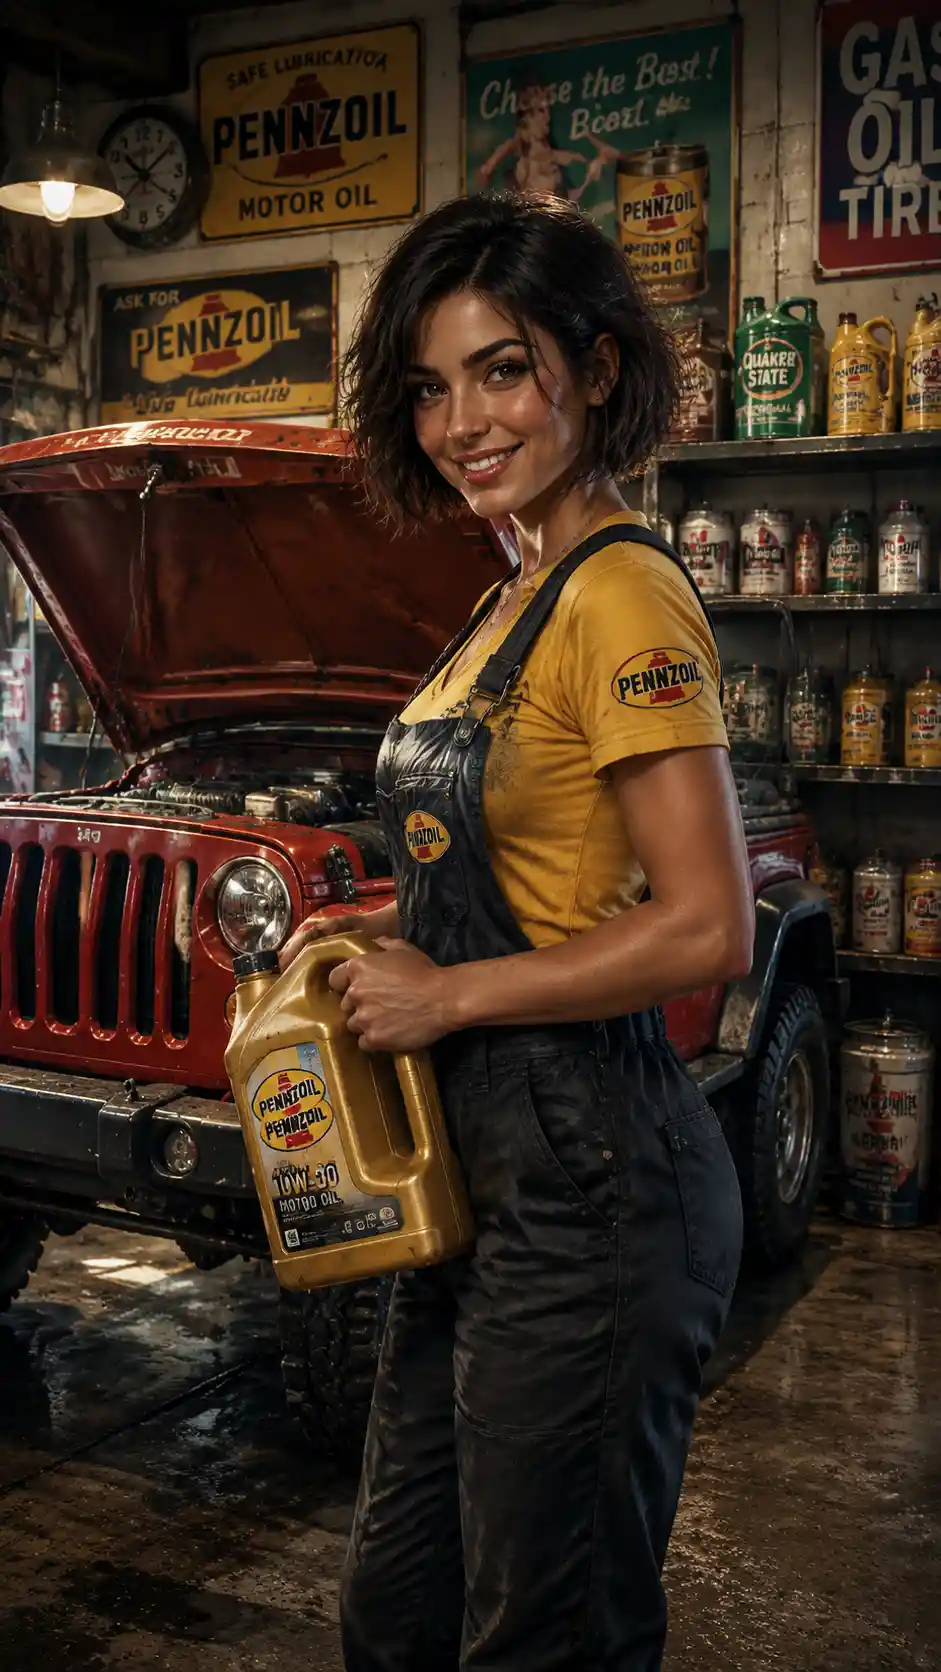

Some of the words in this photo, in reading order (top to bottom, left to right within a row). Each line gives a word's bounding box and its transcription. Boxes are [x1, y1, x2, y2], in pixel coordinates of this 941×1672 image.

[226, 61, 269, 92] SAFE
[580, 65, 626, 101] the
[213, 91, 407, 165] PENNZOIL
[847, 96, 941, 173] OIL
[238, 190, 325, 221] MOTOR
[335, 184, 378, 209] OIL
[113, 292, 145, 312] ASK
[148, 289, 182, 307] FOR
[130, 299, 301, 370] PENNZOIL
[747, 368, 789, 389] STATE
[617, 661, 704, 701] PENNZOIL
[258, 1078, 321, 1118] PENNZOIL
[319, 1190, 343, 1207] OIL
